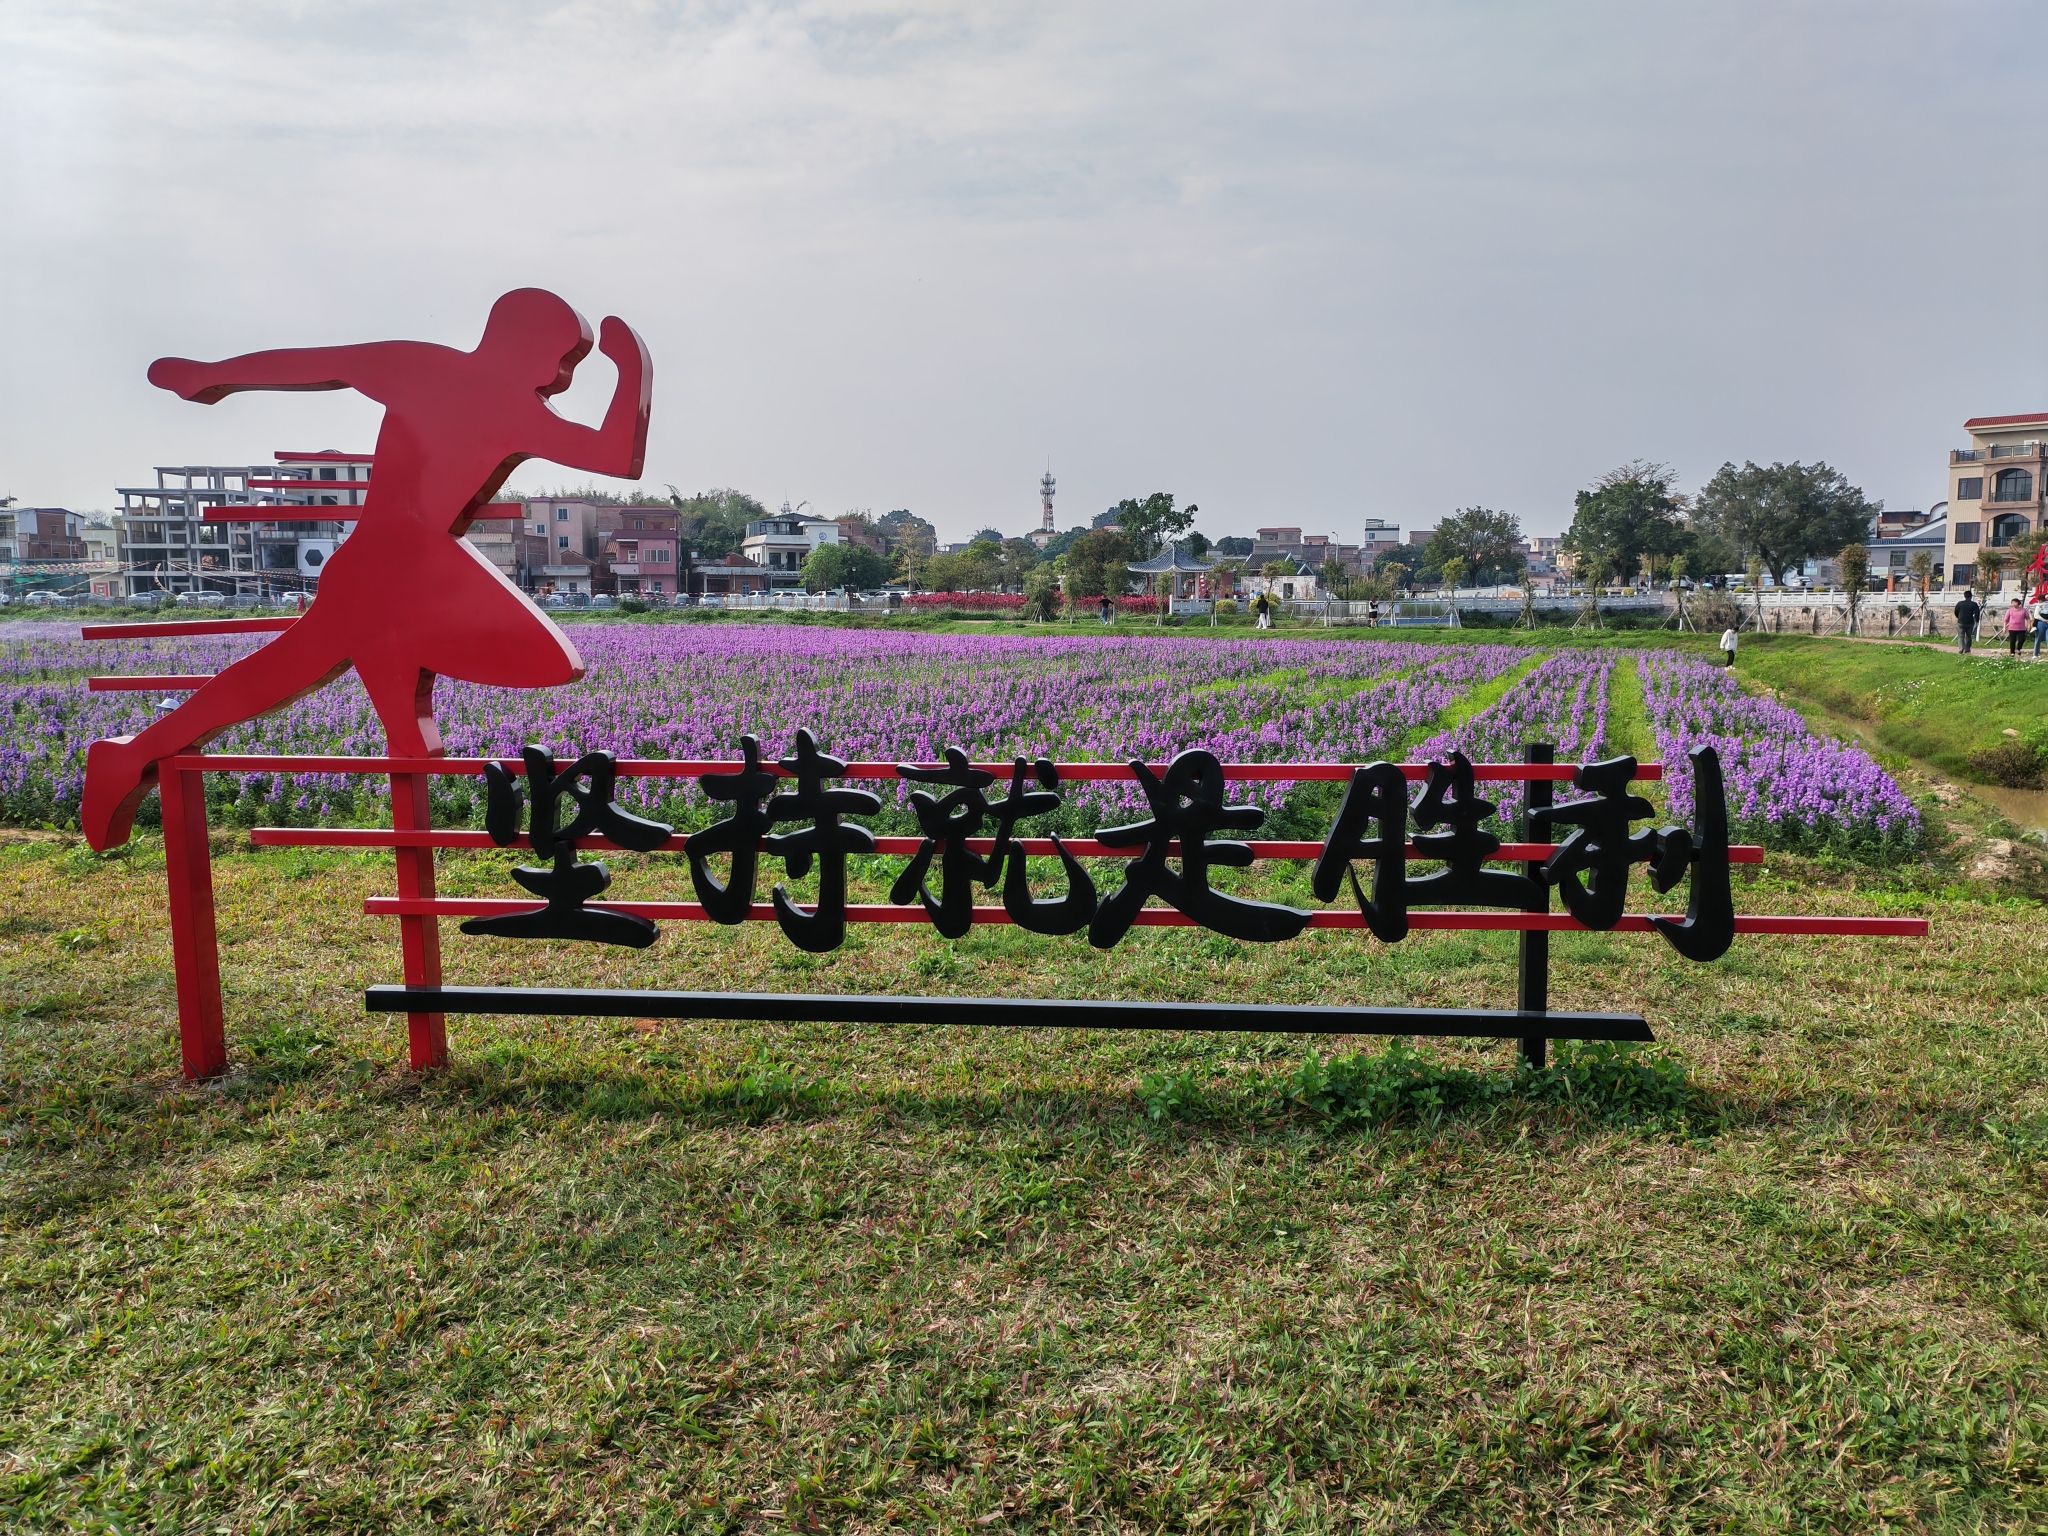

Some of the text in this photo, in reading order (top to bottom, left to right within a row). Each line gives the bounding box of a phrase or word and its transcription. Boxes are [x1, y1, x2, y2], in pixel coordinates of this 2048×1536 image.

[460, 727, 1734, 961] 坚持就是胜利
